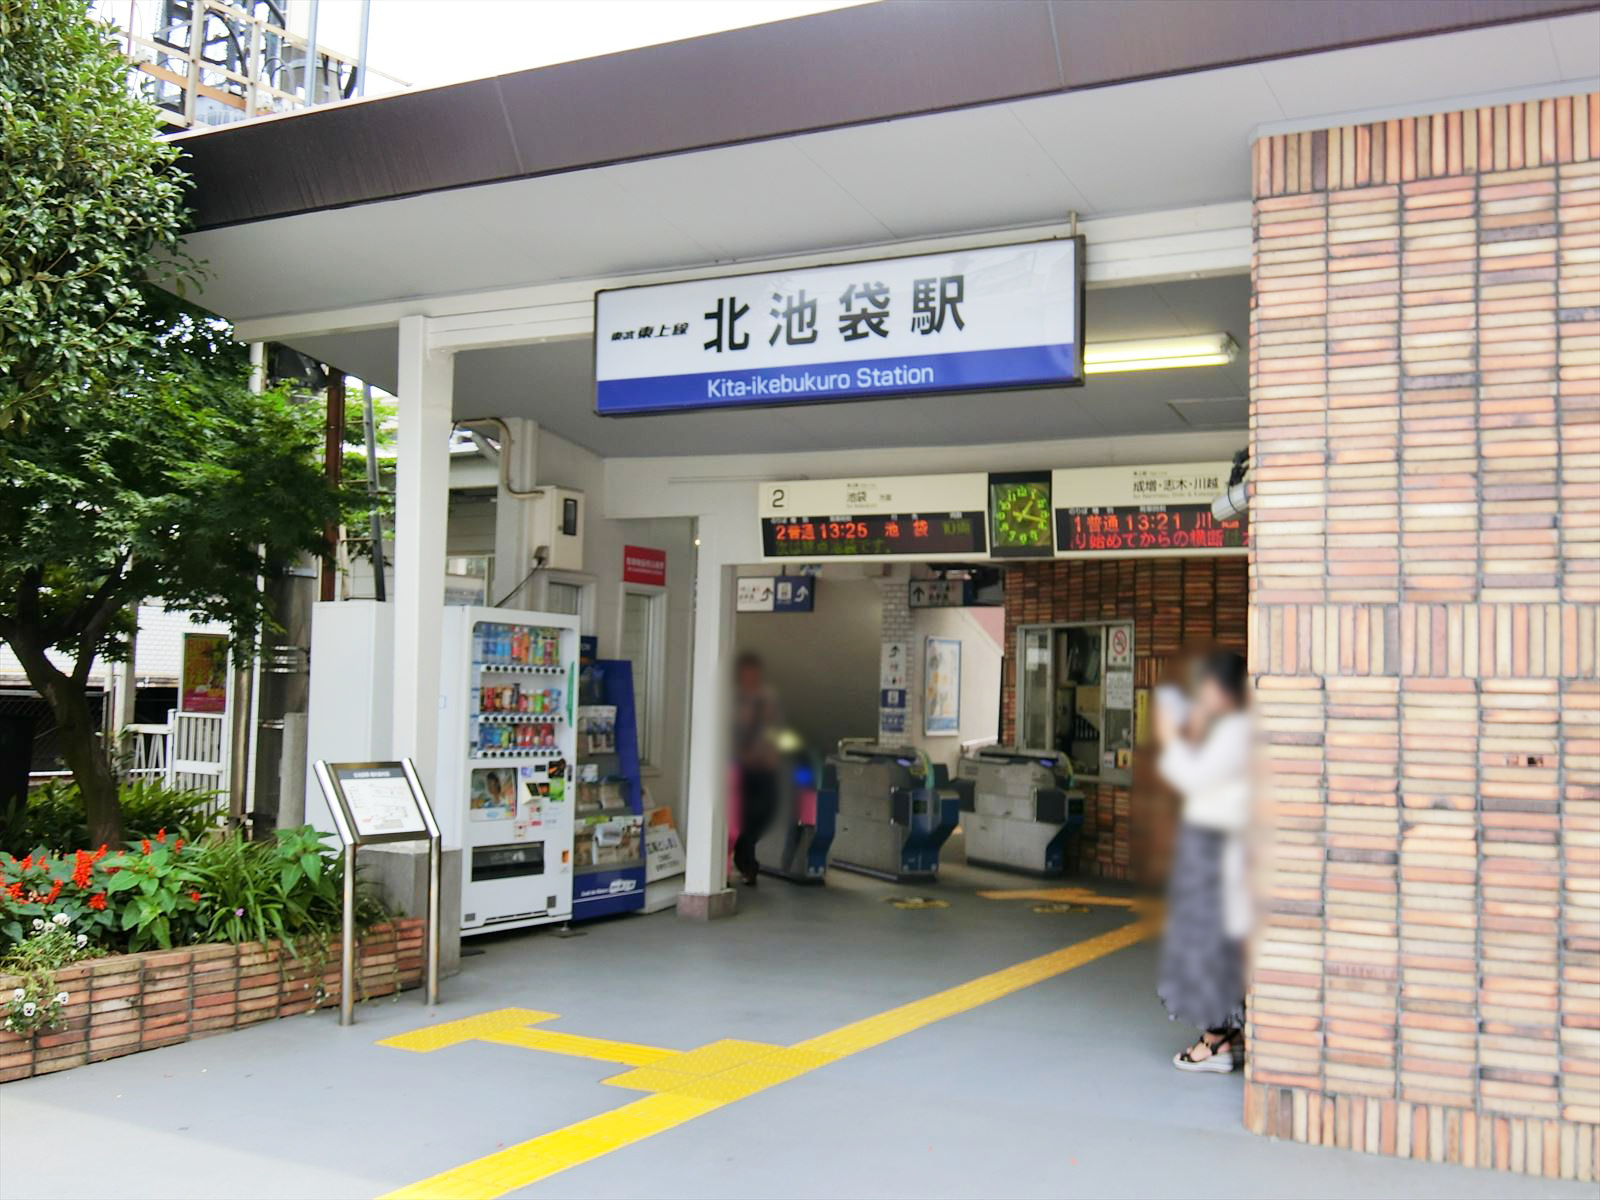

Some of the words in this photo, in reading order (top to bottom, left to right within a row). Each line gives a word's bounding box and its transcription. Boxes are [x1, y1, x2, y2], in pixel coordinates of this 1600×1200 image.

[704, 275, 965, 353] 北池袋駅
[707, 372, 850, 398] Kita-ikebukuro
[857, 365, 934, 388] Station
[772, 489, 785, 507] 2
[776, 525, 785, 540] 2
[820, 522, 868, 539] 13:25
[1087, 514, 1119, 532] 普通
[1126, 513, 1181, 531] 13:21
